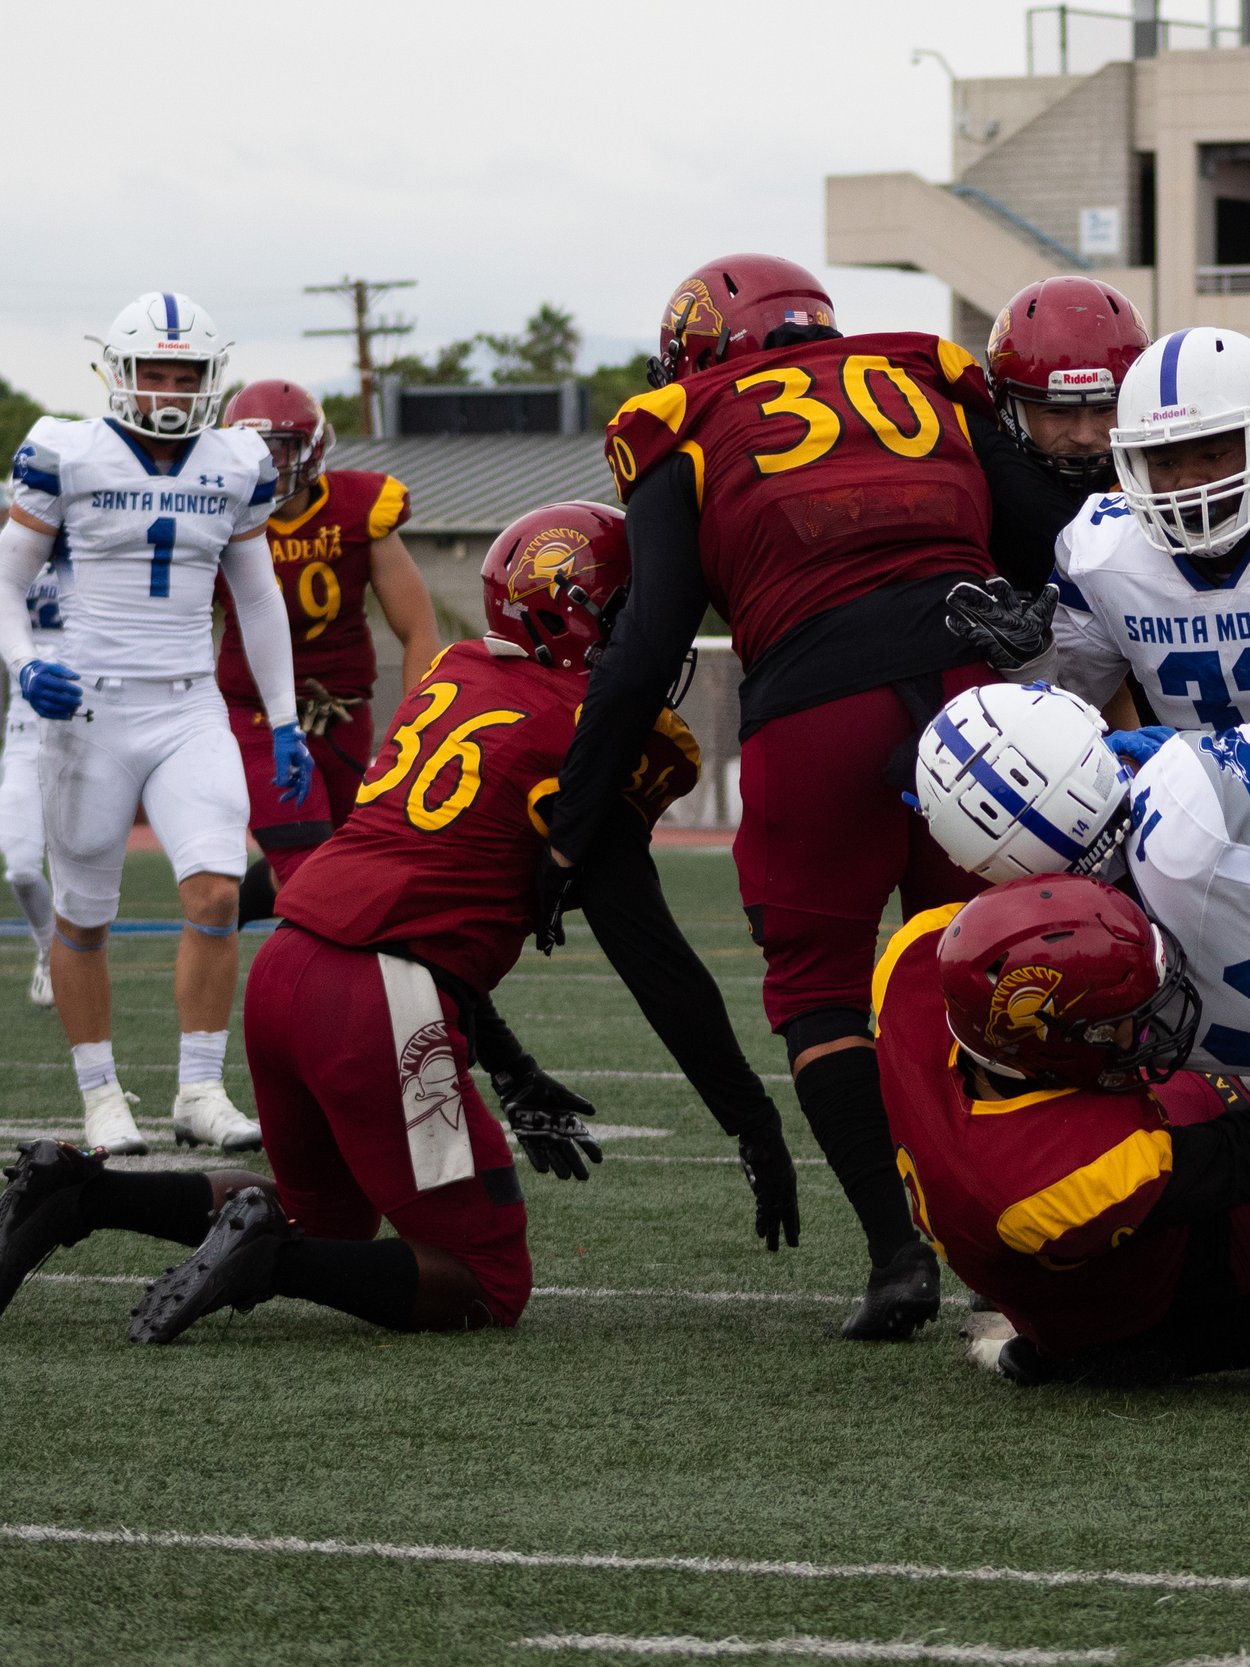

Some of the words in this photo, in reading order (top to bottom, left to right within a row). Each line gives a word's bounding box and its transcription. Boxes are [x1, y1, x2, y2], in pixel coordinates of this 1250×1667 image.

[1063, 372, 1099, 385] Riddell
[734, 355, 942, 478] 30
[1152, 407, 1187, 422] Riddell
[92, 490, 154, 511] SANTA
[160, 492, 229, 515] MONICA
[147, 516, 177, 598] 1
[272, 538, 342, 562] ADENA
[1124, 614, 1209, 644] SANTA
[354, 681, 530, 835] 36
[1072, 819, 1090, 838] 14
